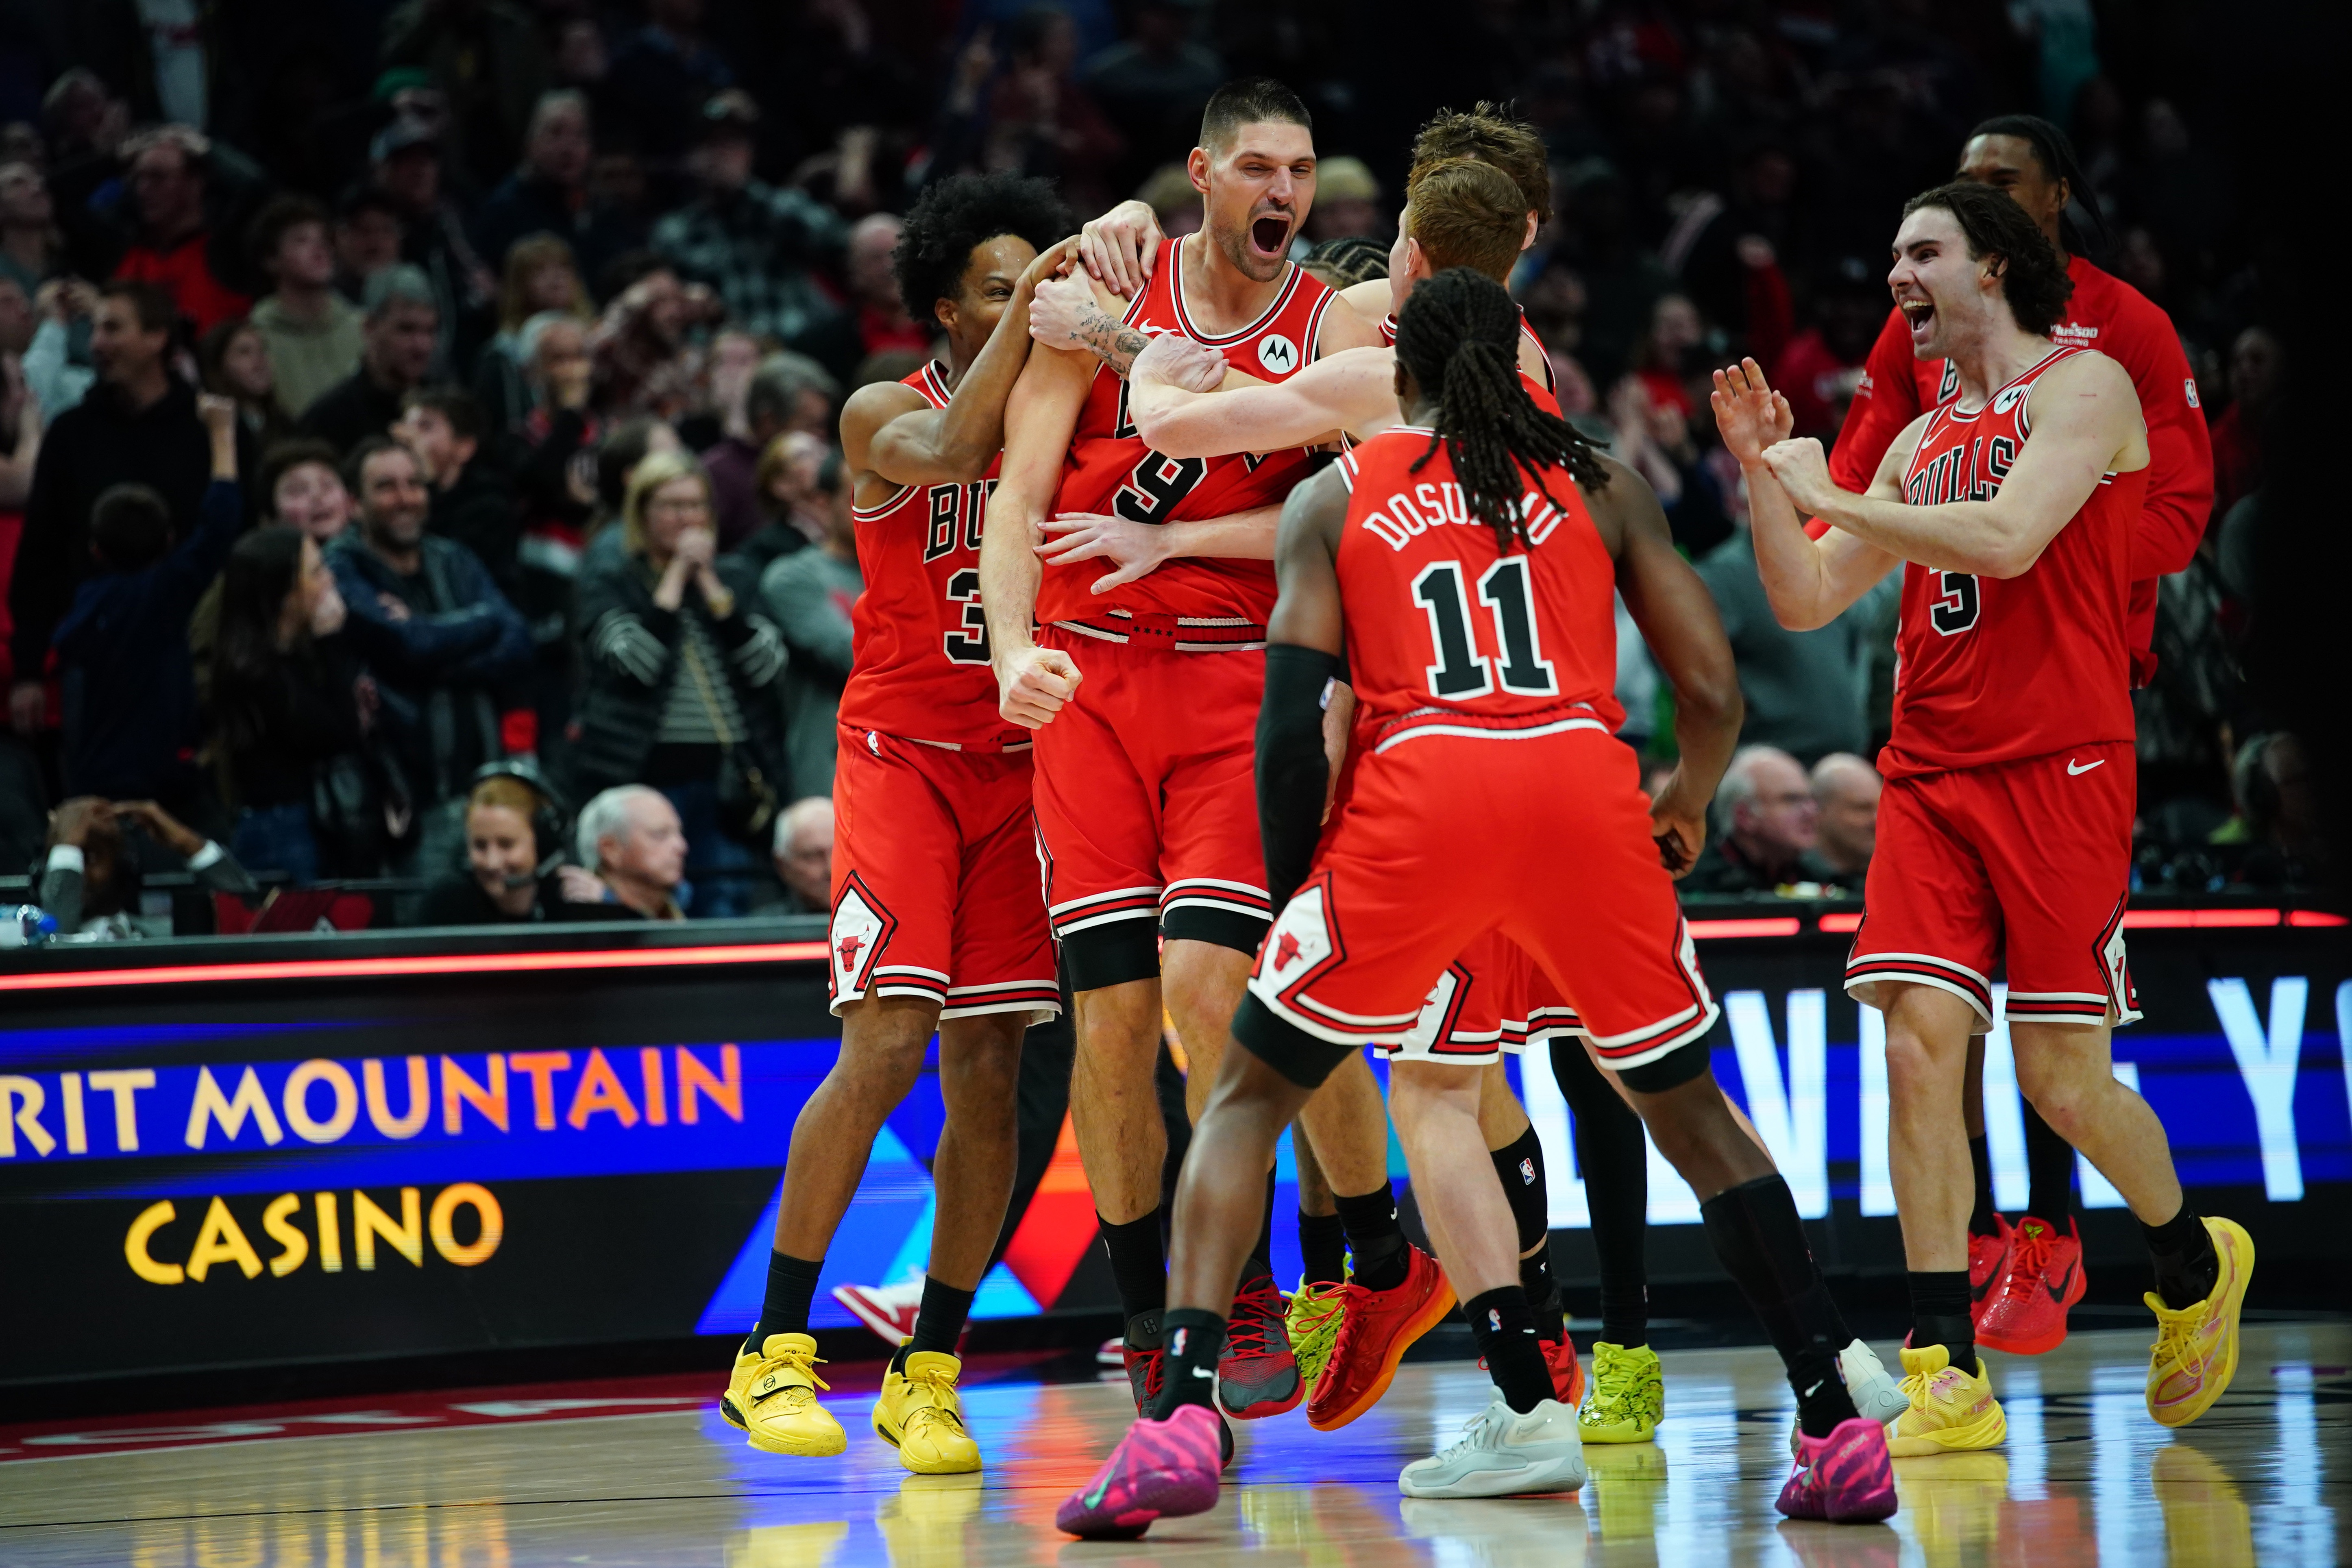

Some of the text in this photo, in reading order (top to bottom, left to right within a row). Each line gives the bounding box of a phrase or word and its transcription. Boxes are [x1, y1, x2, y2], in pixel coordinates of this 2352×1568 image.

[2054, 336, 2089, 347] TRADING
[923, 478, 1000, 564] BU
[1111, 449, 1208, 525] 9
[1362, 482, 1569, 552] DOSUU
[943, 568, 991, 666] 3
[1410, 555, 1559, 701] 11
[0, 1043, 744, 1158] RIT MOUNTAIN
[2207, 976, 2352, 1202] Y
[124, 1183, 503, 1285] CASINO
